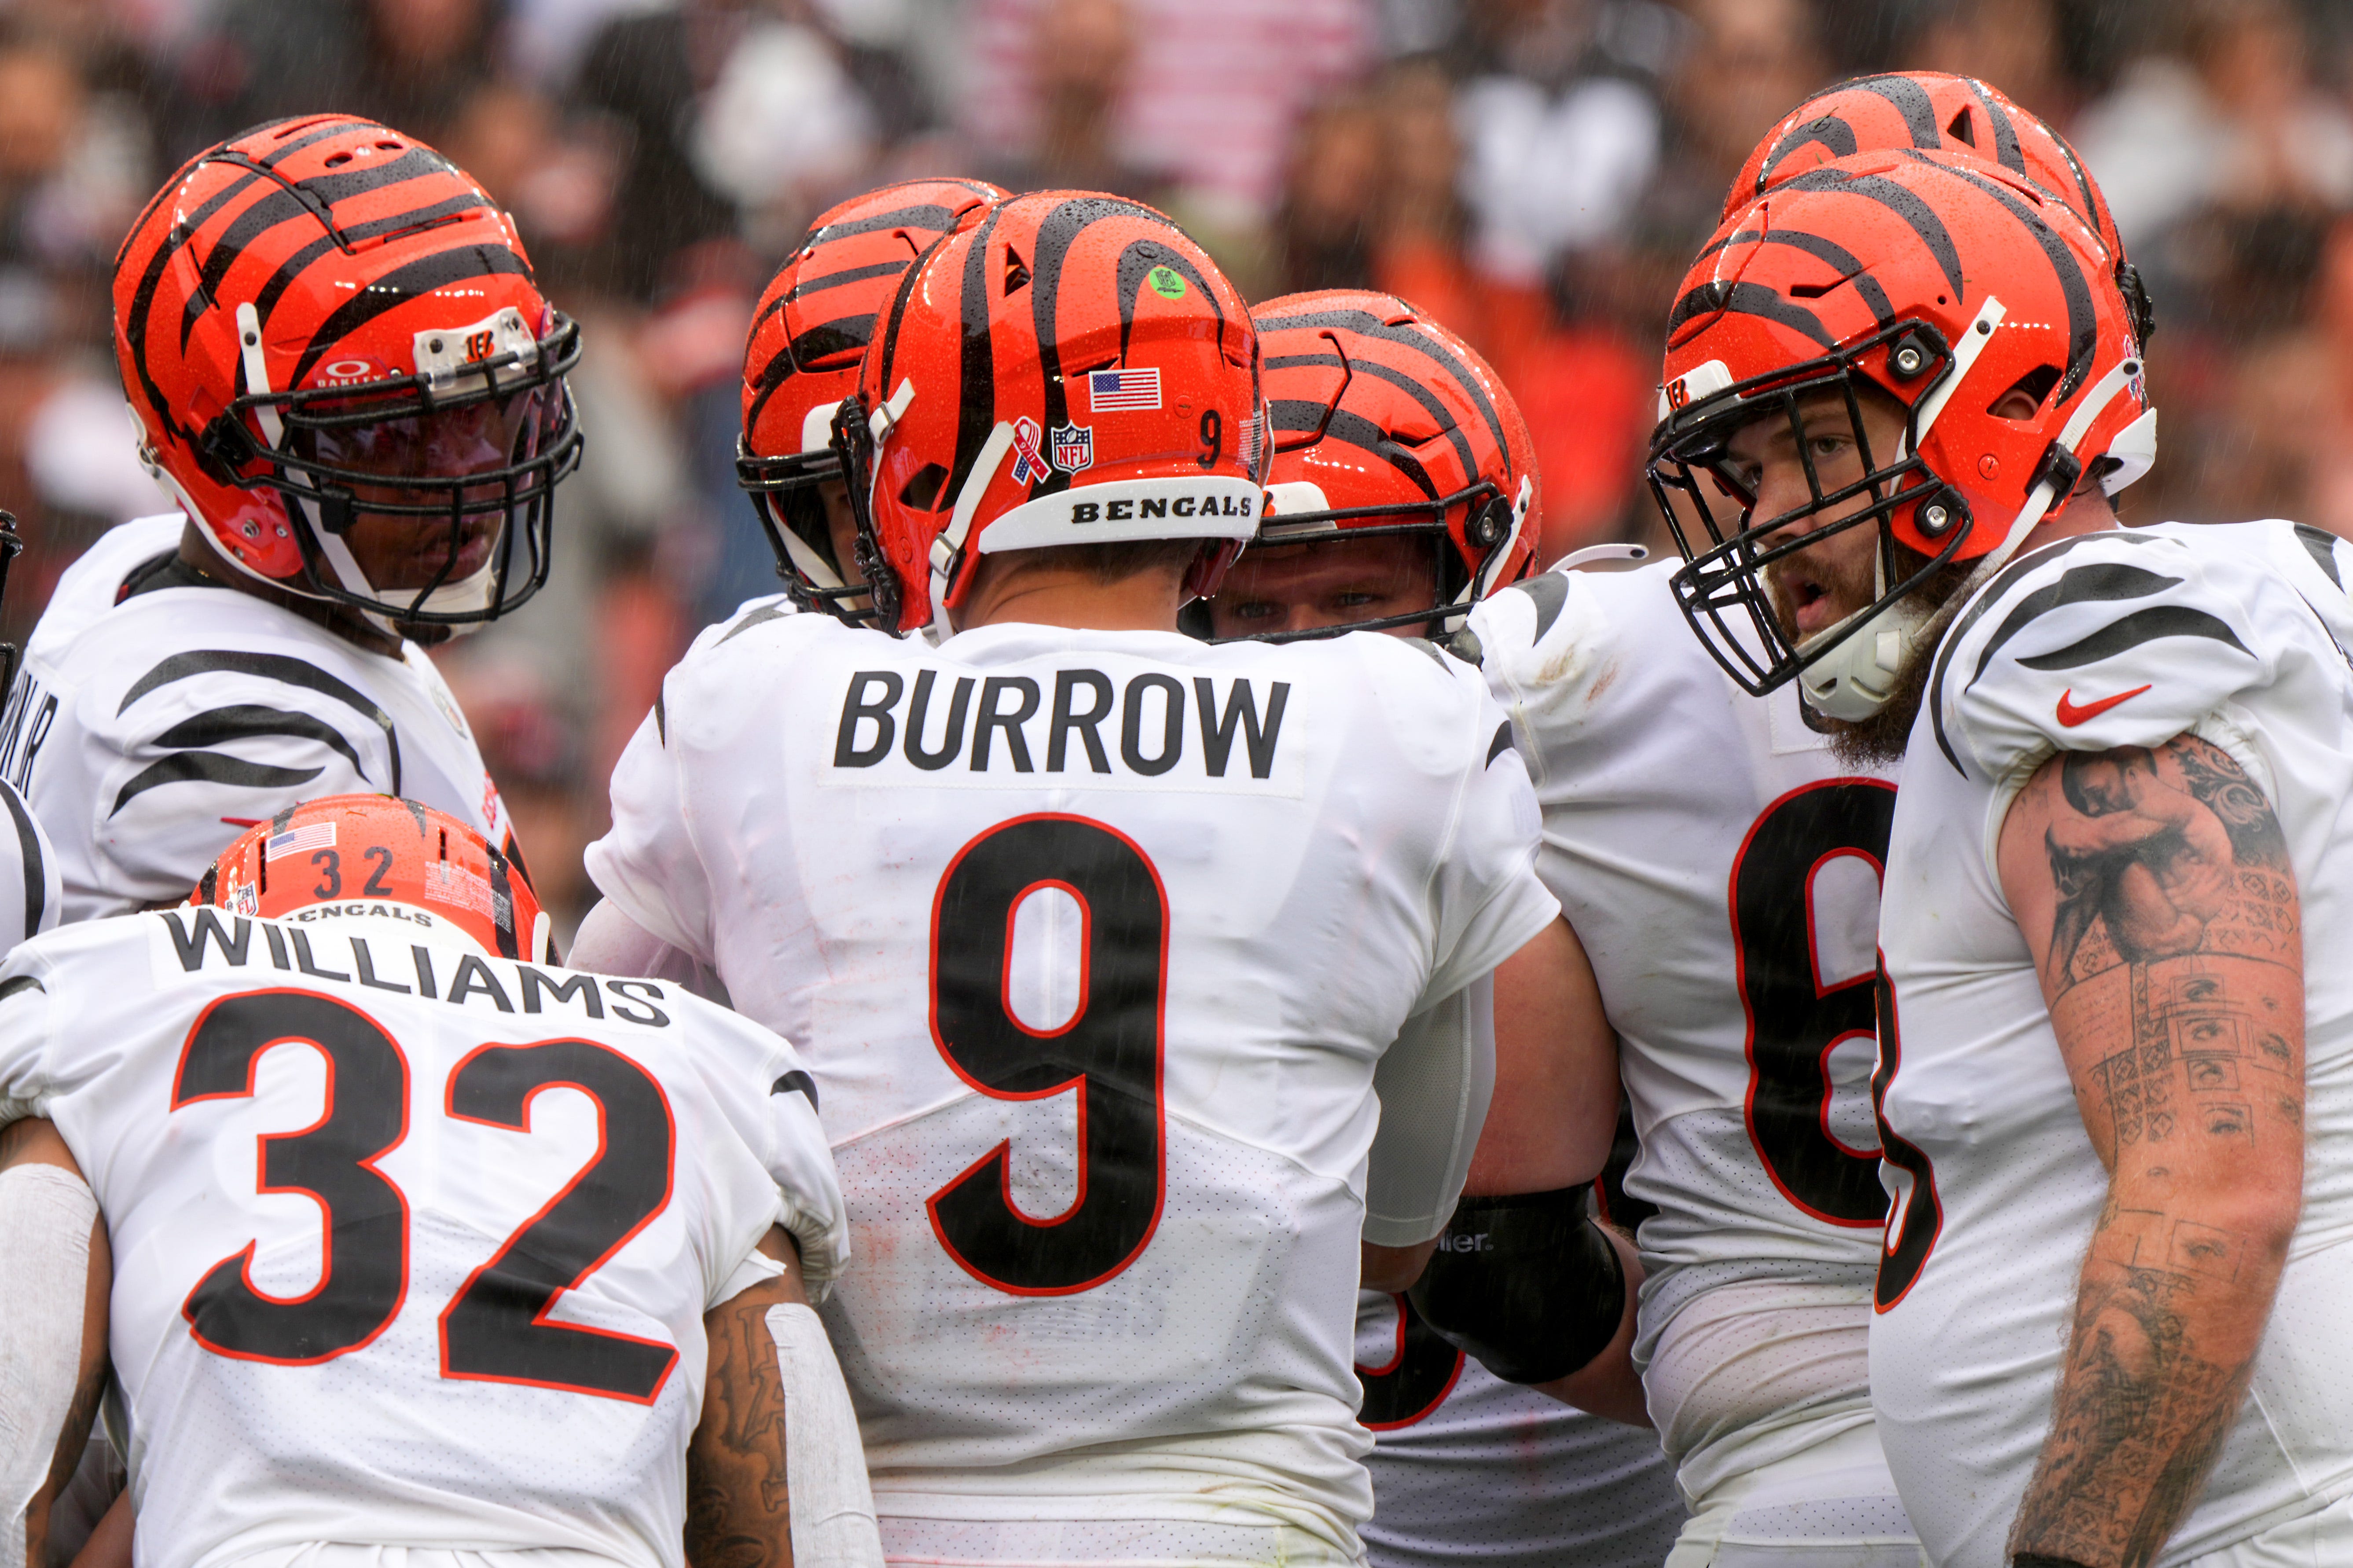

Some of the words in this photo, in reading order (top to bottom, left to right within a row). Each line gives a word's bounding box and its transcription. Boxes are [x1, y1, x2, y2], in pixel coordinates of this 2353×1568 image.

[1019, 441, 1035, 462] 9/11
[1057, 445, 1088, 467] NFL
[1197, 410, 1221, 469] 9
[1071, 496, 1251, 524] BENGALS
[833, 669, 1291, 779] BURROW
[285, 905, 432, 927] ENGALS
[160, 909, 670, 1028] WILLIAMS
[926, 811, 1171, 1297] 9
[170, 986, 680, 1407] 32
[1437, 1228, 1489, 1253] ller
